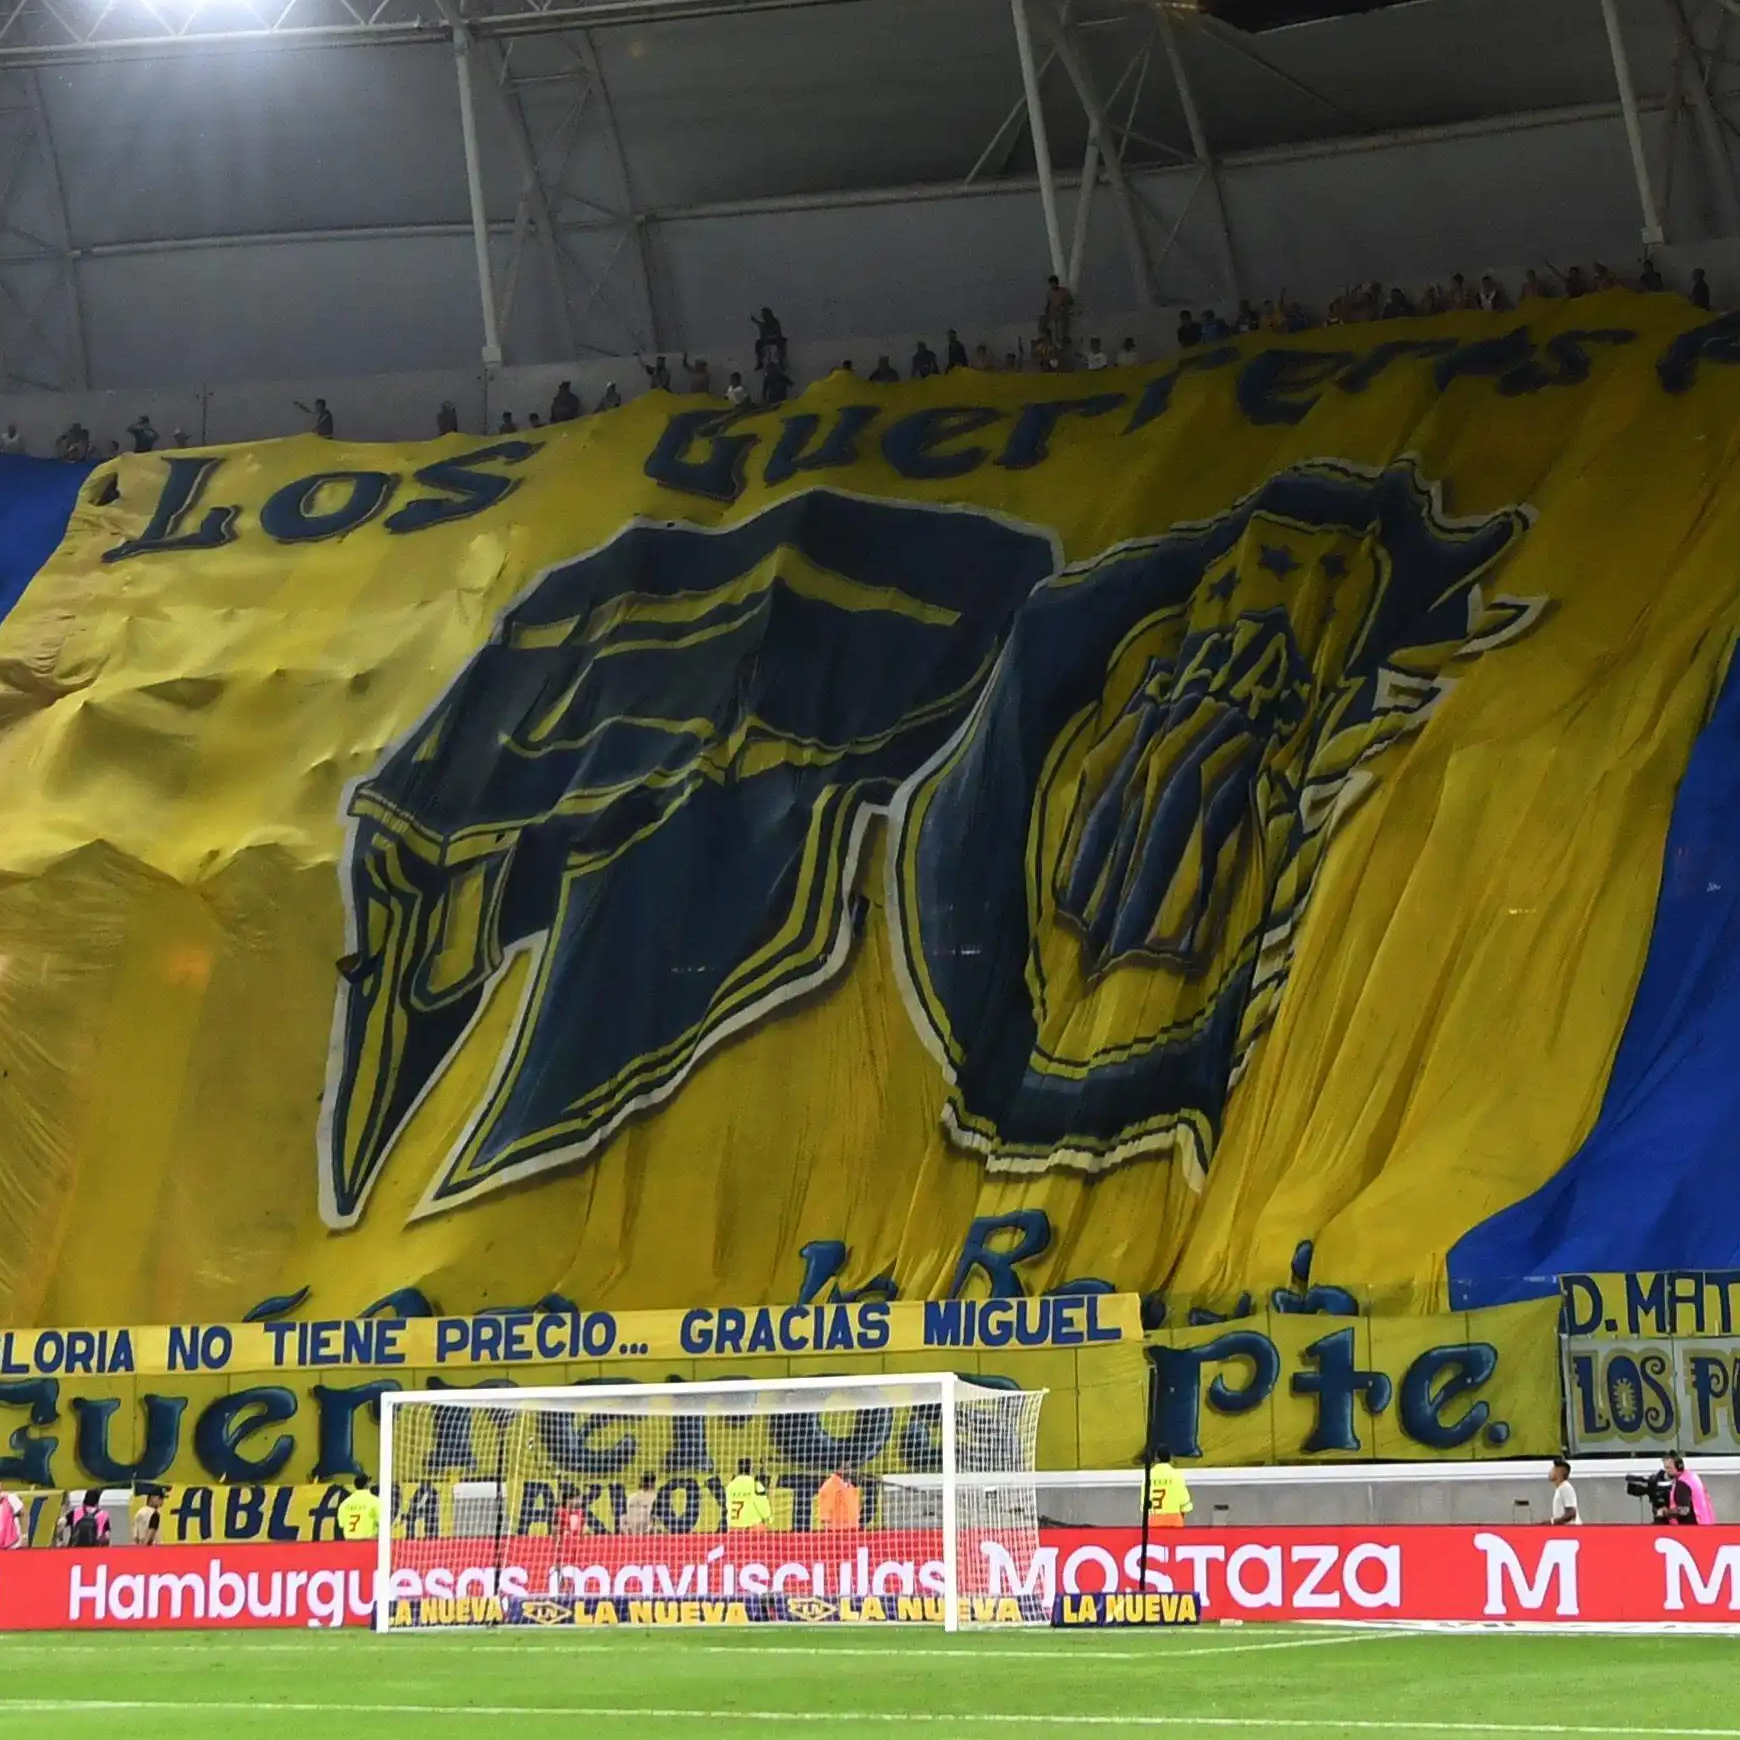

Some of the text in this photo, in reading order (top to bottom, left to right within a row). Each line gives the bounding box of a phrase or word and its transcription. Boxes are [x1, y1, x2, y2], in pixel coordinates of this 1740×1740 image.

[168, 1323, 233, 1371] NO
[265, 1316, 407, 1367] TIENE
[681, 1300, 892, 1354] GRACIAS
[924, 1293, 1123, 1347] MIGUEL
[1573, 1352, 1676, 1434] LOS
[420, 1596, 503, 1625] NUEVA
[573, 1599, 618, 1626] LA
[630, 1599, 749, 1625] NUEVA
[840, 1595, 886, 1623] LA
[1063, 1593, 1198, 1624] LA NUEVA
